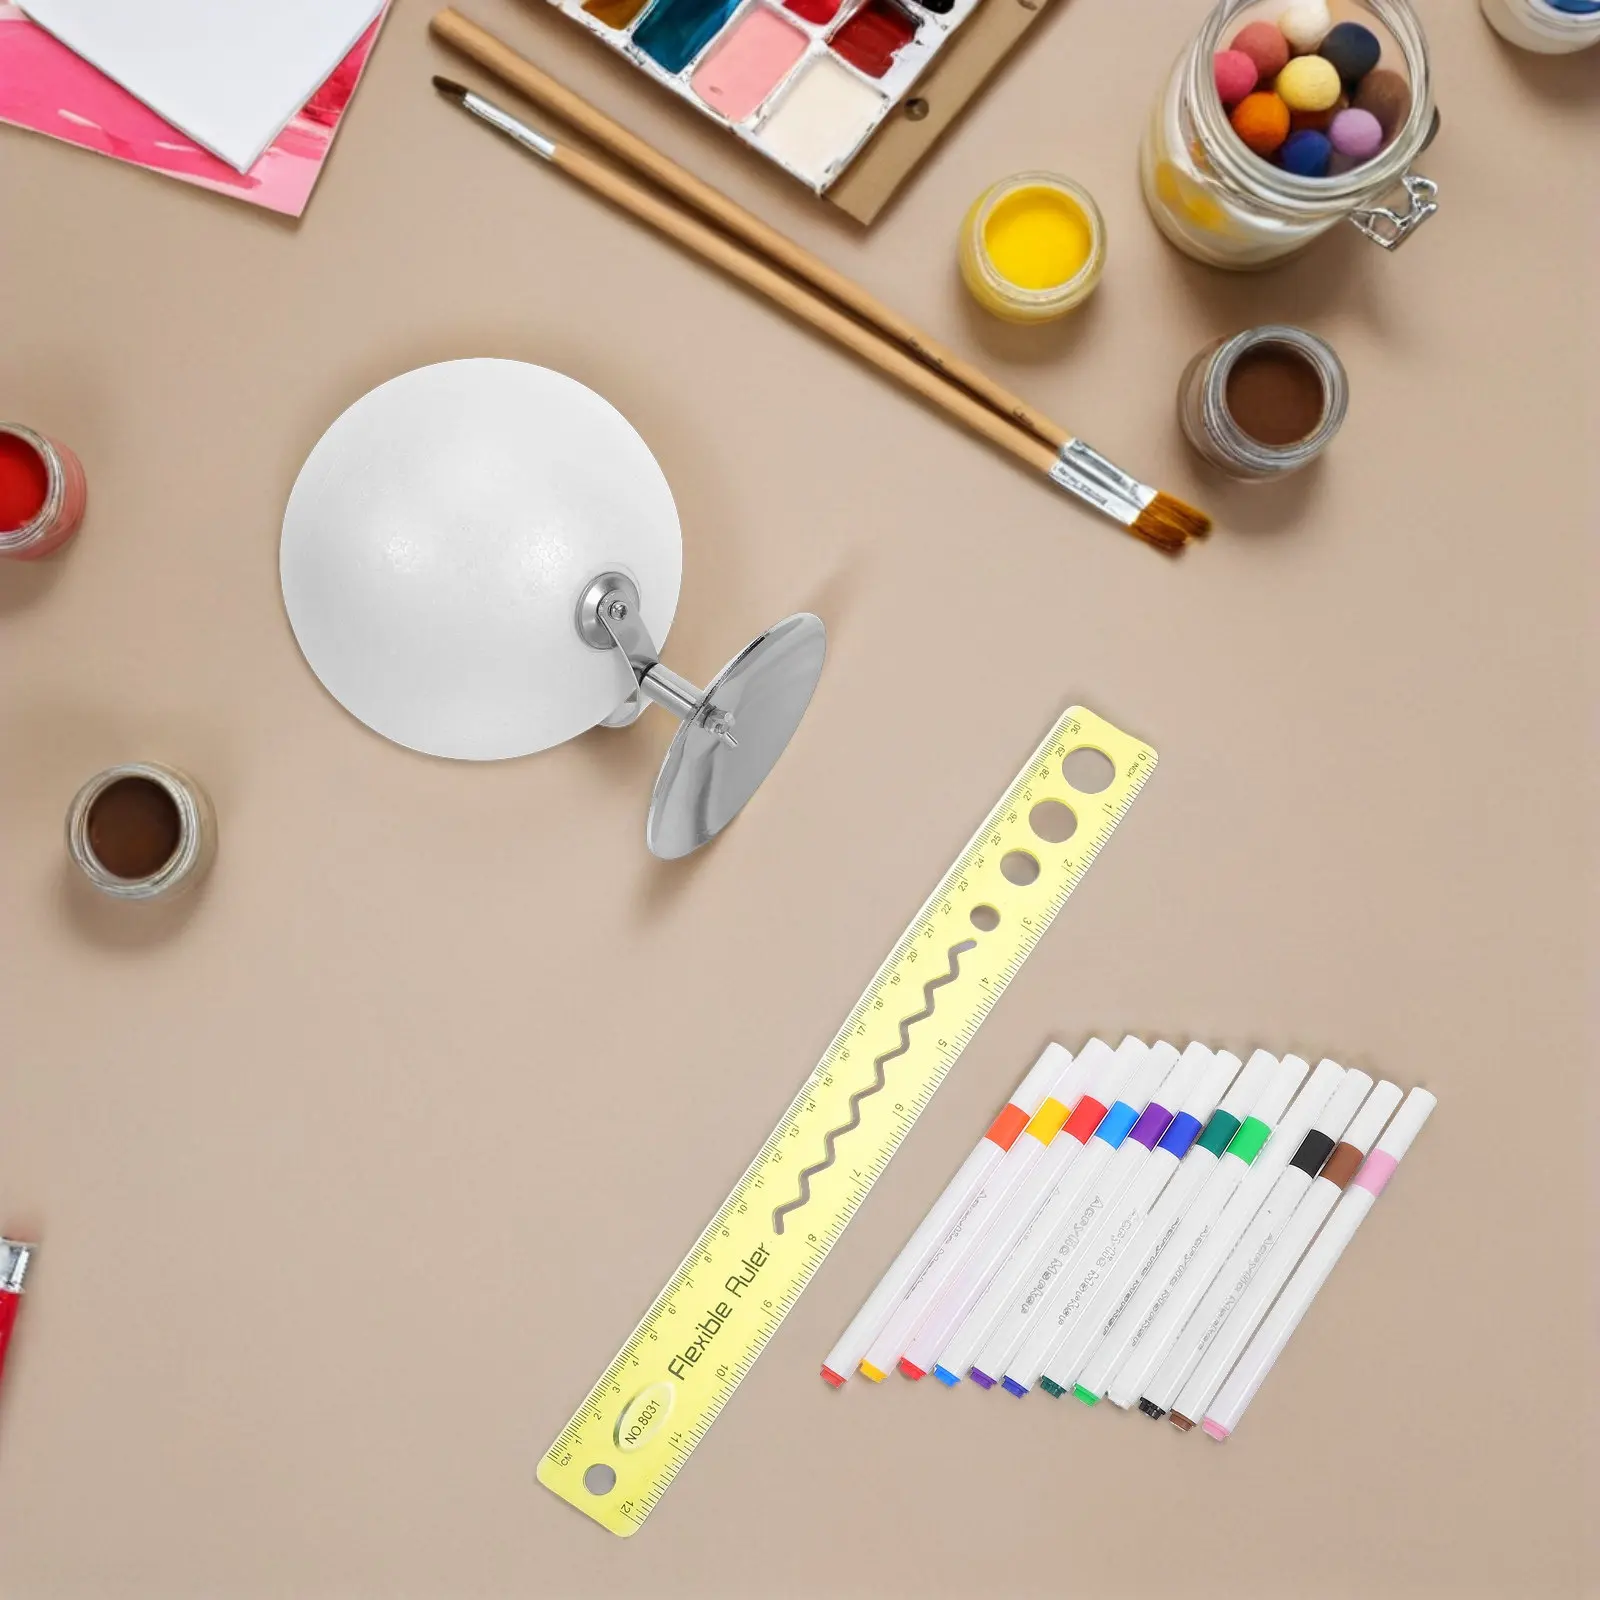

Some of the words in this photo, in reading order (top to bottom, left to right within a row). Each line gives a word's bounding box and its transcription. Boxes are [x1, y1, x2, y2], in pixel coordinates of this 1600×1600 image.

[1127, 762, 1139, 778] INCH
[1064, 858, 1072, 867] 2
[938, 1038, 947, 1047] 5
[561, 1453, 572, 1465] CM
[738, 1205, 747, 1214] 10
[755, 1179, 765, 1188] 11
[772, 1153, 782, 1164] 12
[789, 1127, 799, 1138] 13
[806, 1102, 816, 1112] 14
[824, 1076, 833, 1086] 15
[840, 1051, 850, 1061] 16
[856, 1025, 866, 1036] 17
[874, 1001, 883, 1010] 18
[890, 975, 900, 986] 19
[907, 951, 918, 962] 20
[924, 928, 934, 938] 21
[941, 904, 951, 914] 22
[958, 881, 968, 891] 23
[974, 858, 984, 868] 24
[991, 834, 1001, 846] 25
[1007, 813, 1017, 823] 26
[1024, 790, 1033, 800] 27
[1040, 768, 1049, 779] 28
[1055, 746, 1066, 757] 29
[1070, 723, 1081, 734] 30
[854, 1169, 861, 1177] 7
[1060, 1196, 1104, 1255] Acrylic
[1020, 1259, 1062, 1314] Marker
[668, 1302, 732, 1380] Flexible
[725, 1242, 770, 1298] Ruler
[717, 1364, 728, 1376] 10
[624, 1400, 660, 1444] NO.8031
[671, 1432, 682, 1442] 11
[621, 1500, 634, 1513] 12
